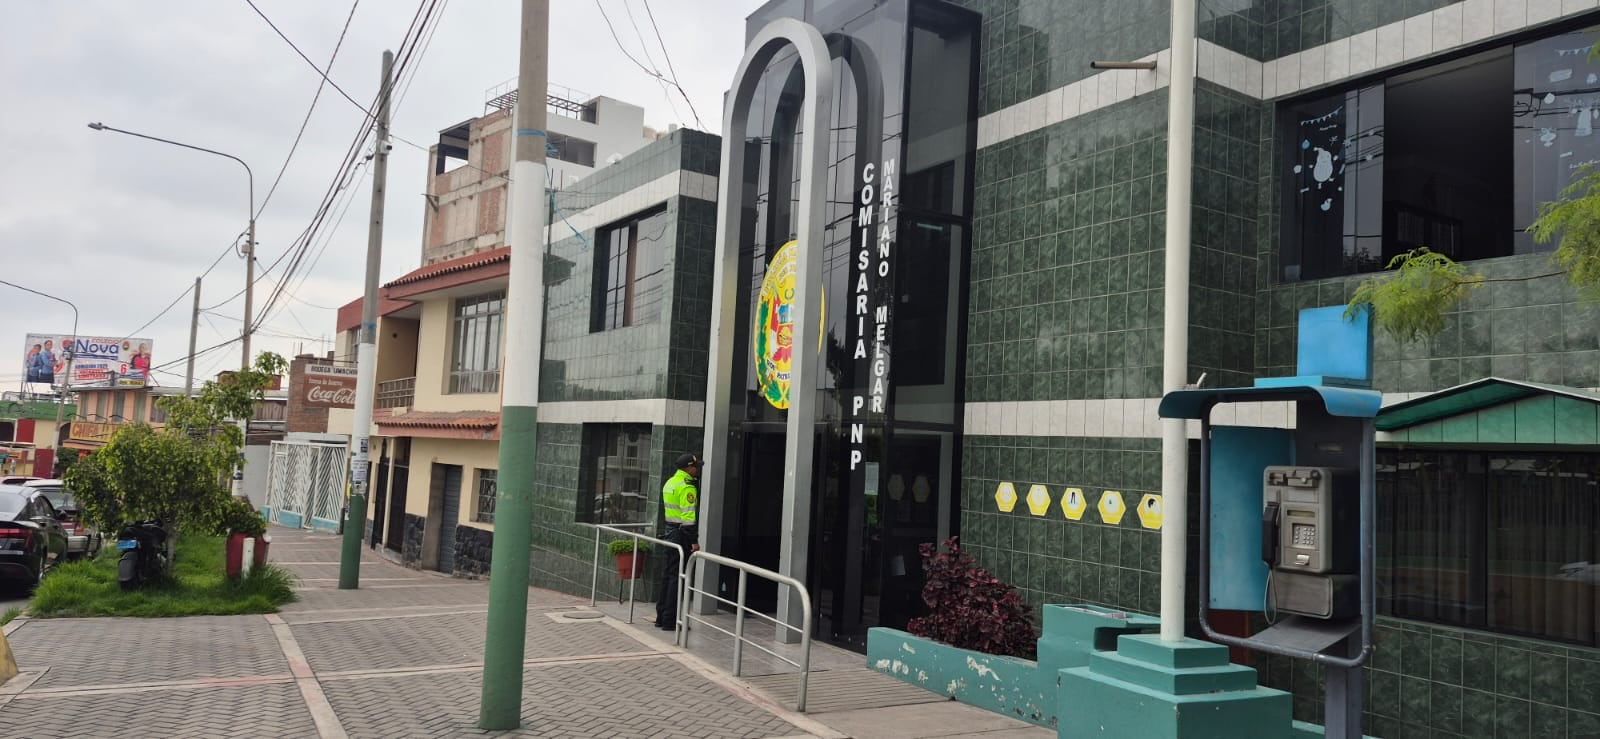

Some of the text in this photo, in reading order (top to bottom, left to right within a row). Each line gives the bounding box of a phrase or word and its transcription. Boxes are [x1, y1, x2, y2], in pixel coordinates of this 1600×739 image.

[850, 162, 875, 470] COMISARIA PNP
[872, 157, 896, 413] MARIANO MELGAR
[72, 424, 98, 437] CHIFA
